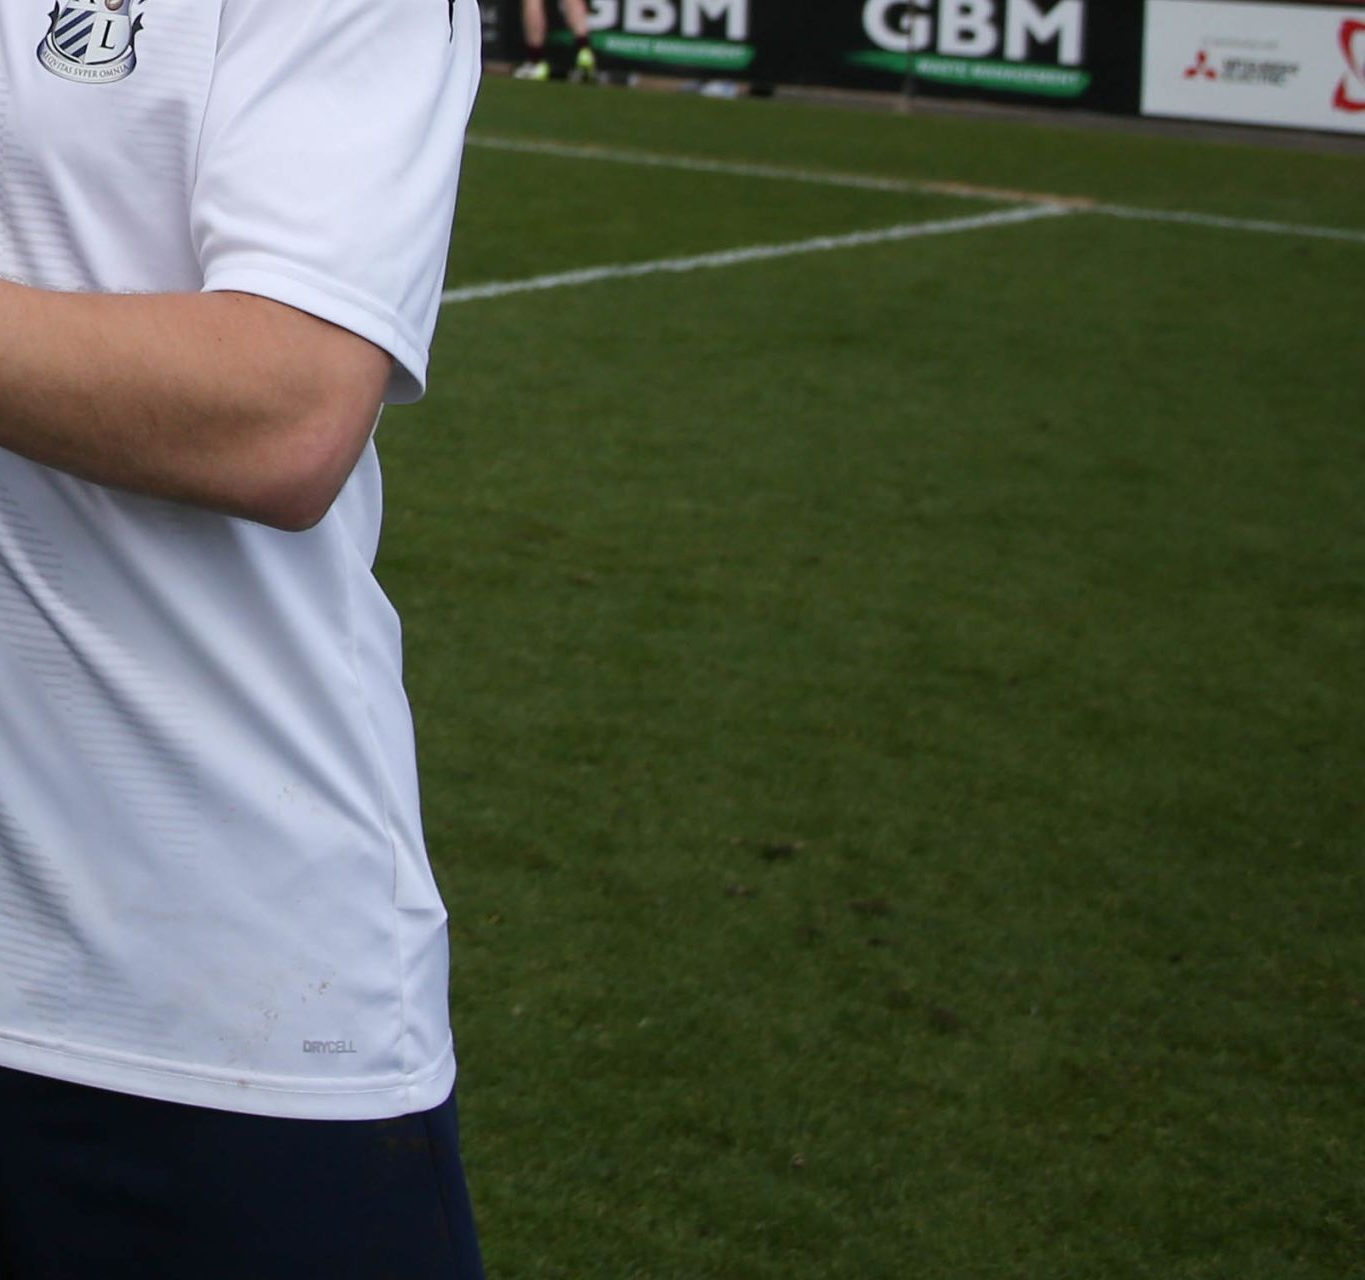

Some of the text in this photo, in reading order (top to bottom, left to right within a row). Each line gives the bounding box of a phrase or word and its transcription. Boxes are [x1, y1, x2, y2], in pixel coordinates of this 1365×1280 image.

[100, 19, 116, 50] L
[99, 64, 130, 78] OMNIA
[303, 1040, 357, 1053] DRYCELL
